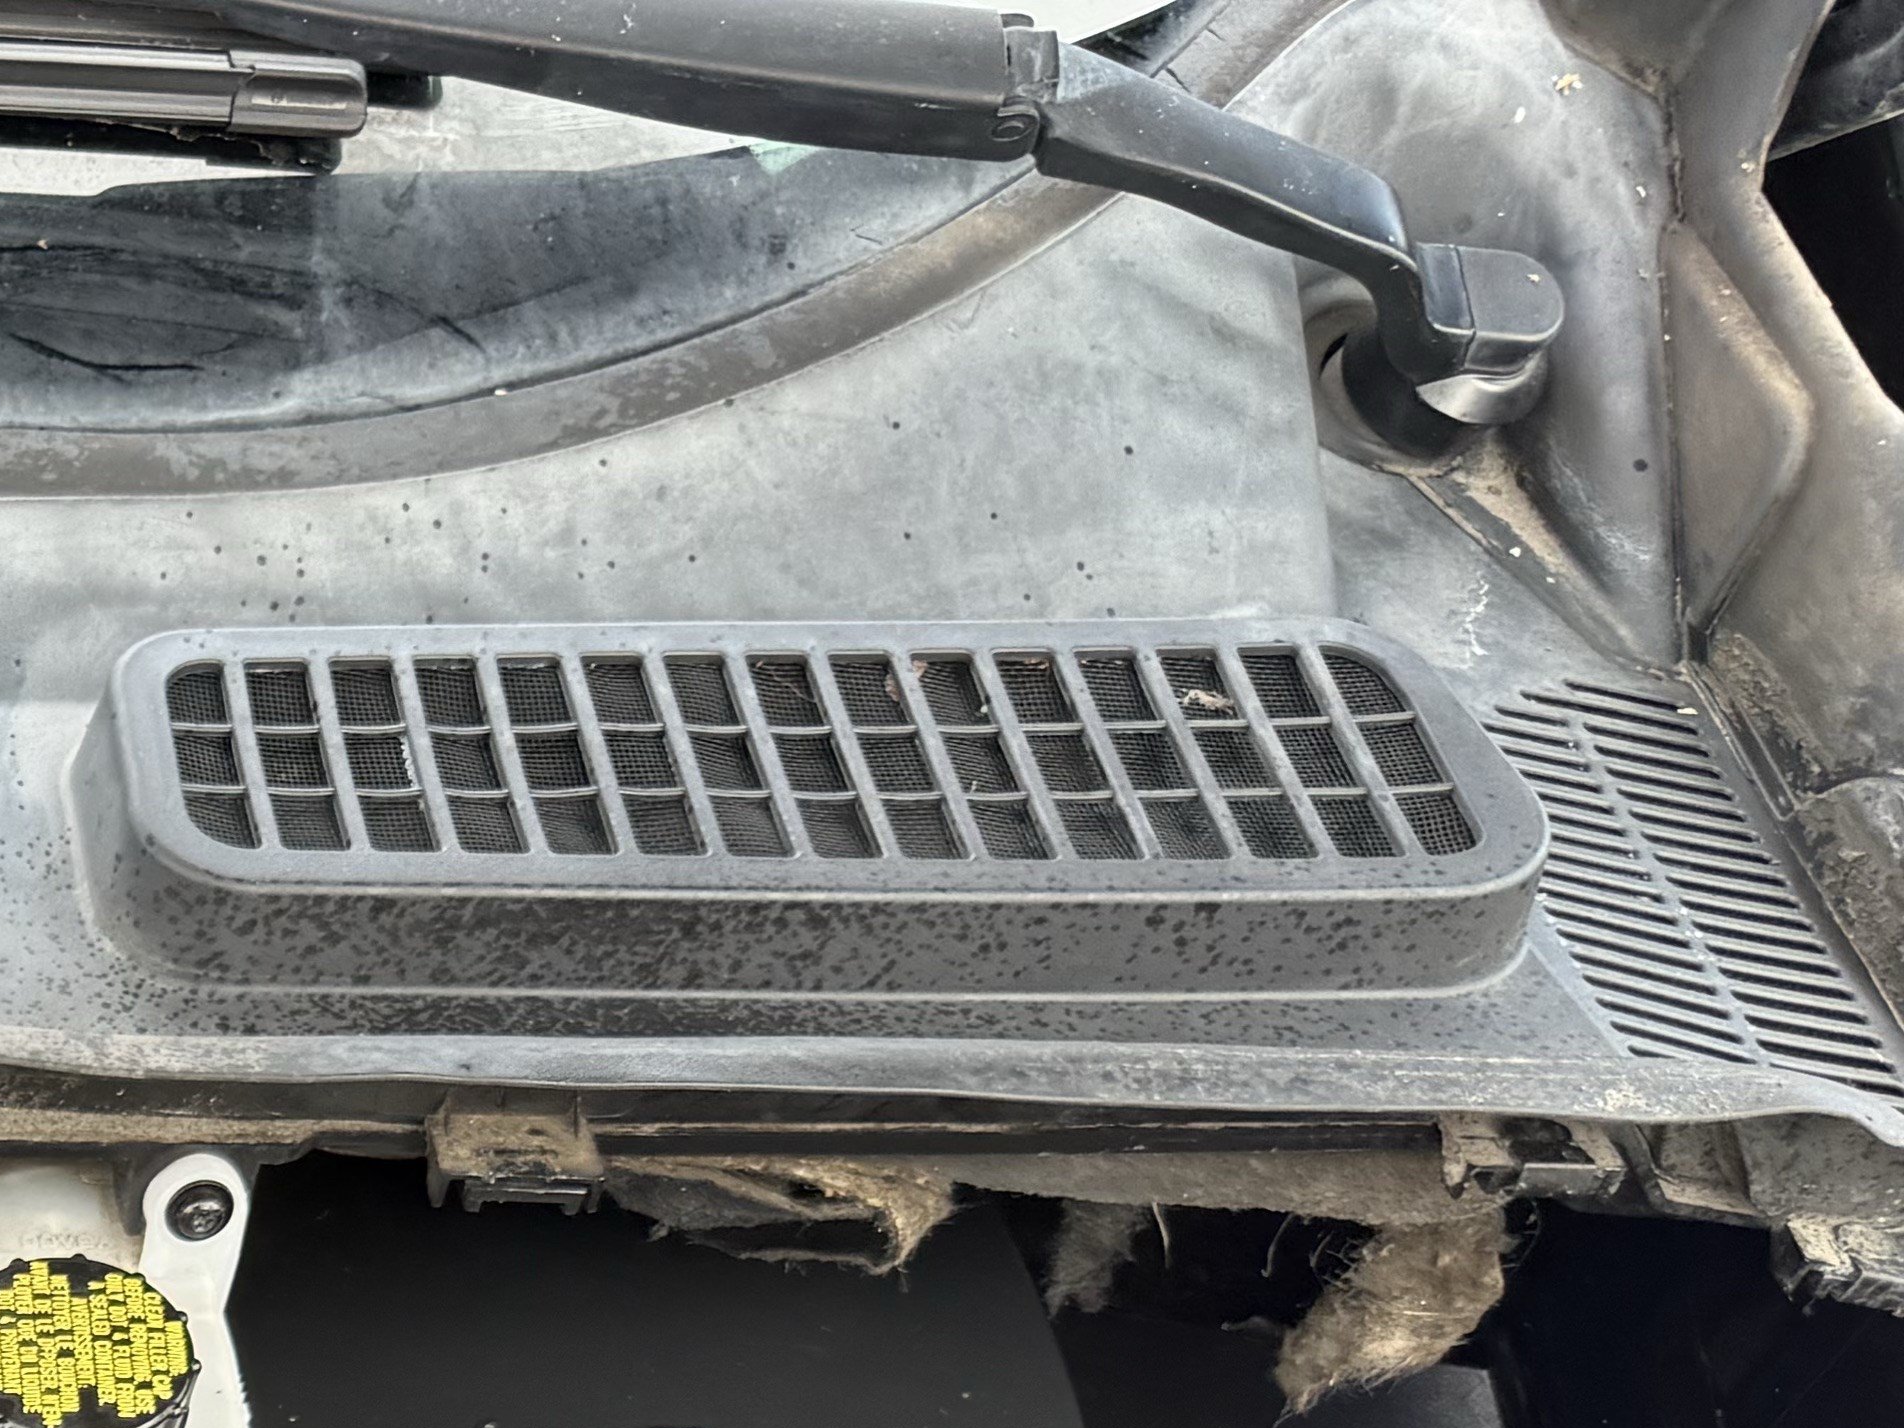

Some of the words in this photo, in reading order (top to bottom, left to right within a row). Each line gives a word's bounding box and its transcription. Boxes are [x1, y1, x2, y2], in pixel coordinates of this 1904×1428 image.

[106, 1273, 124, 1301] ONLY
[34, 1299, 51, 1314] DE
[91, 1295, 111, 1335] SEALED
[110, 1307, 127, 1328] DOT
[144, 1292, 163, 1328] CLEAN
[35, 1319, 52, 1334] LE
[21, 1346, 37, 1363] DU
[54, 1336, 74, 1350] LE
[124, 1279, 144, 1319] BEFORE
[136, 1390, 155, 1414] USE
[148, 1333, 166, 1371] FILLER
[114, 1346, 131, 1378] FLUID
[117, 1383, 135, 1417] FROM
[153, 1375, 171, 1399] CAP
